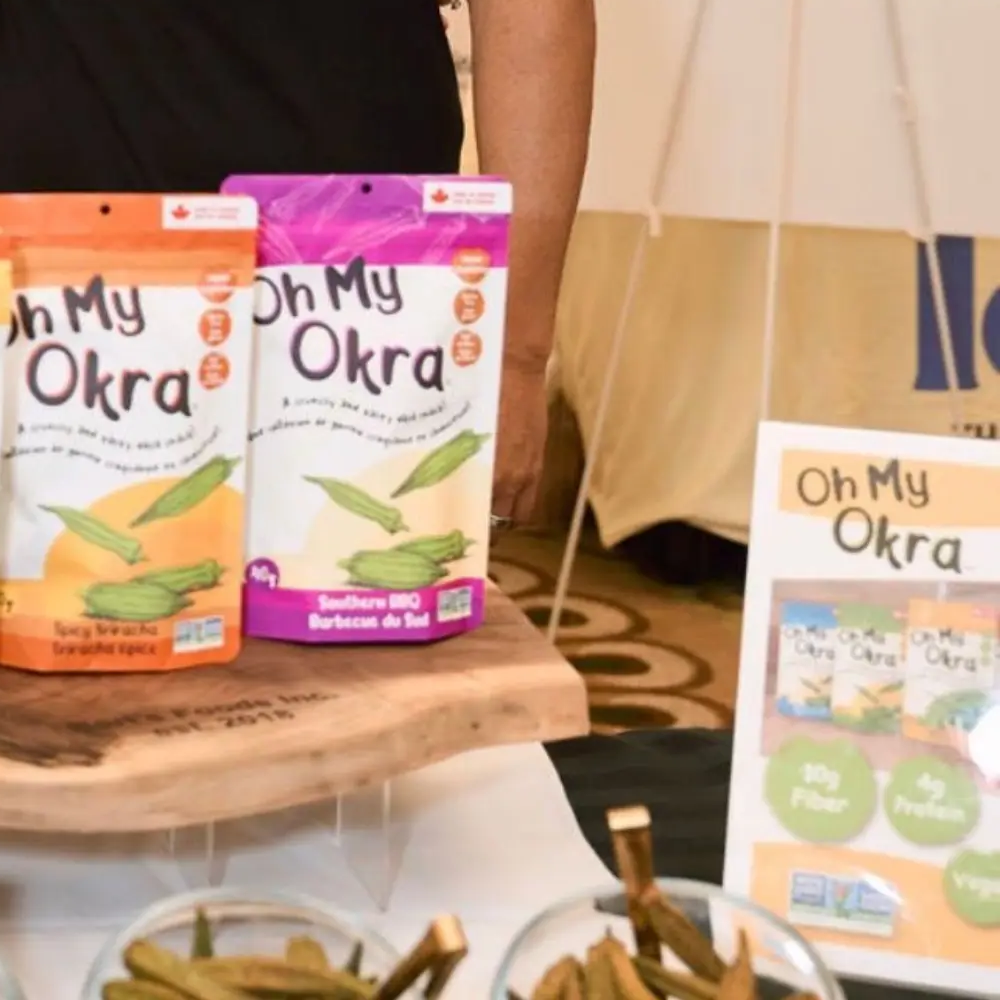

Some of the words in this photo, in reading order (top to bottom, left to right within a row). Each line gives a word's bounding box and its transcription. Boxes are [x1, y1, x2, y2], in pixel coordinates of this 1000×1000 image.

[6, 293, 54, 347] h
[63, 273, 146, 337] My
[324, 255, 404, 315] My
[26, 340, 192, 422] Okra
[290, 319, 445, 396] Okra
[796, 465, 857, 507] Oh
[866, 458, 931, 509] My
[832, 506, 963, 574] Okra
[850, 643, 897, 668] Okra
[925, 644, 978, 672] Okra
